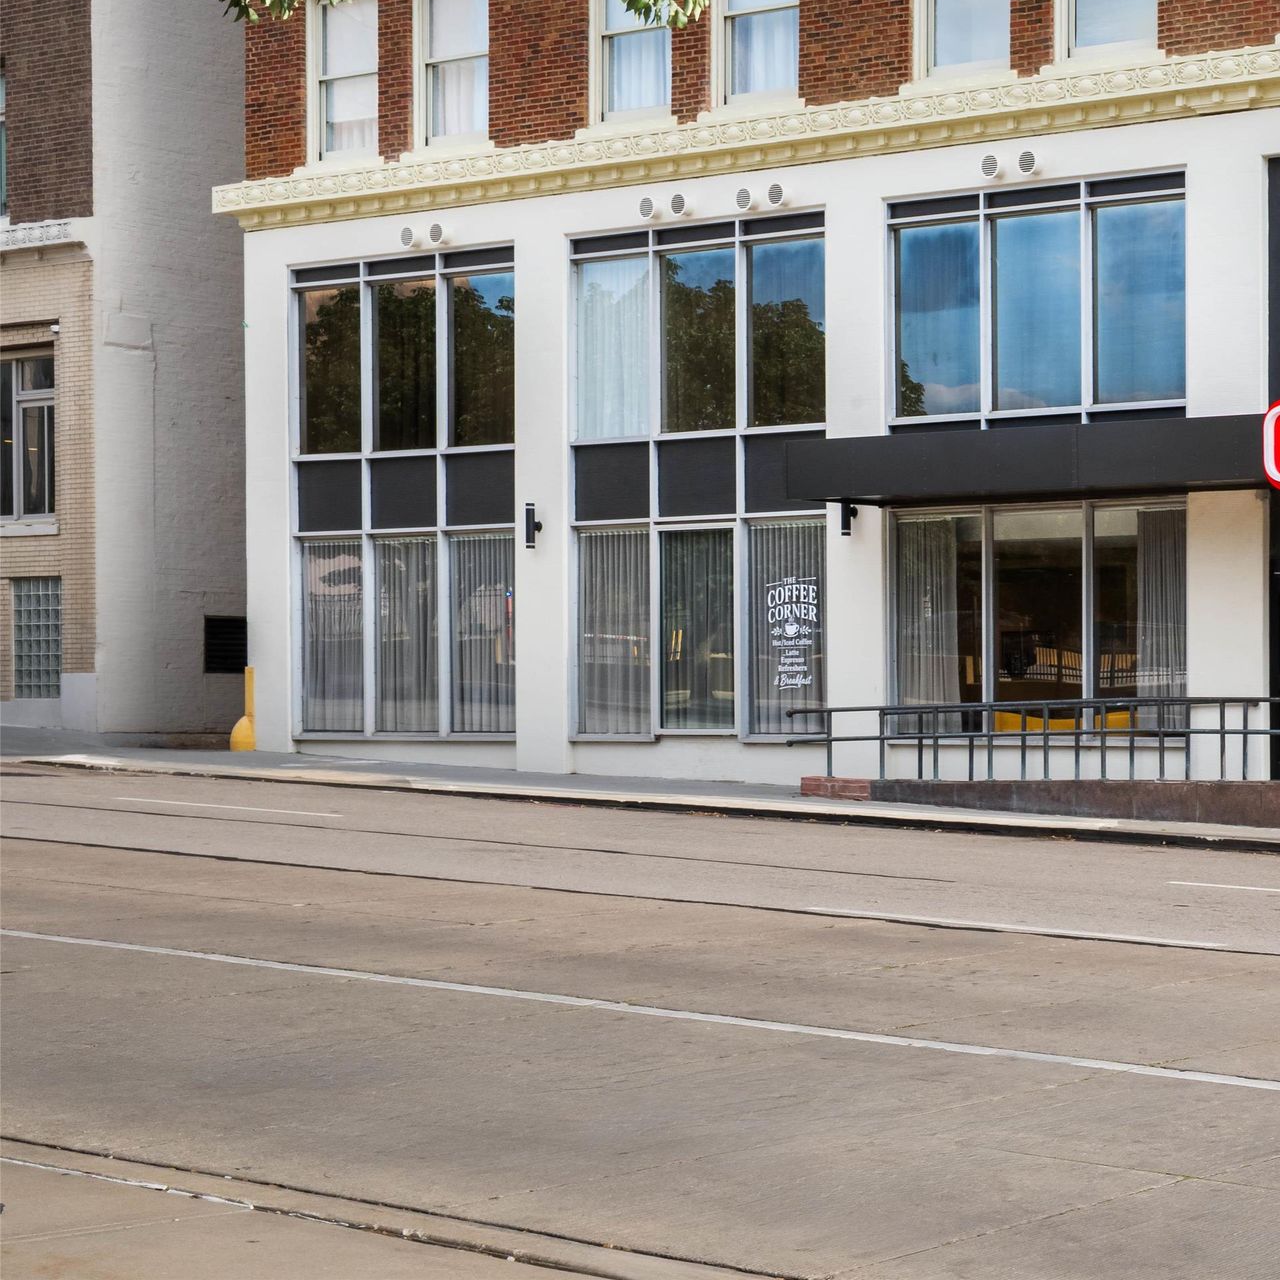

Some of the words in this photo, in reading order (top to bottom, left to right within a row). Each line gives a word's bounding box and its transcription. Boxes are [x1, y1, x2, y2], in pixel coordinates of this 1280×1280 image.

[783, 577, 797, 585] THE
[767, 584, 818, 607] COFFEE
[768, 603, 818, 623] CORNER
[780, 673, 812, 688] Breakfast
